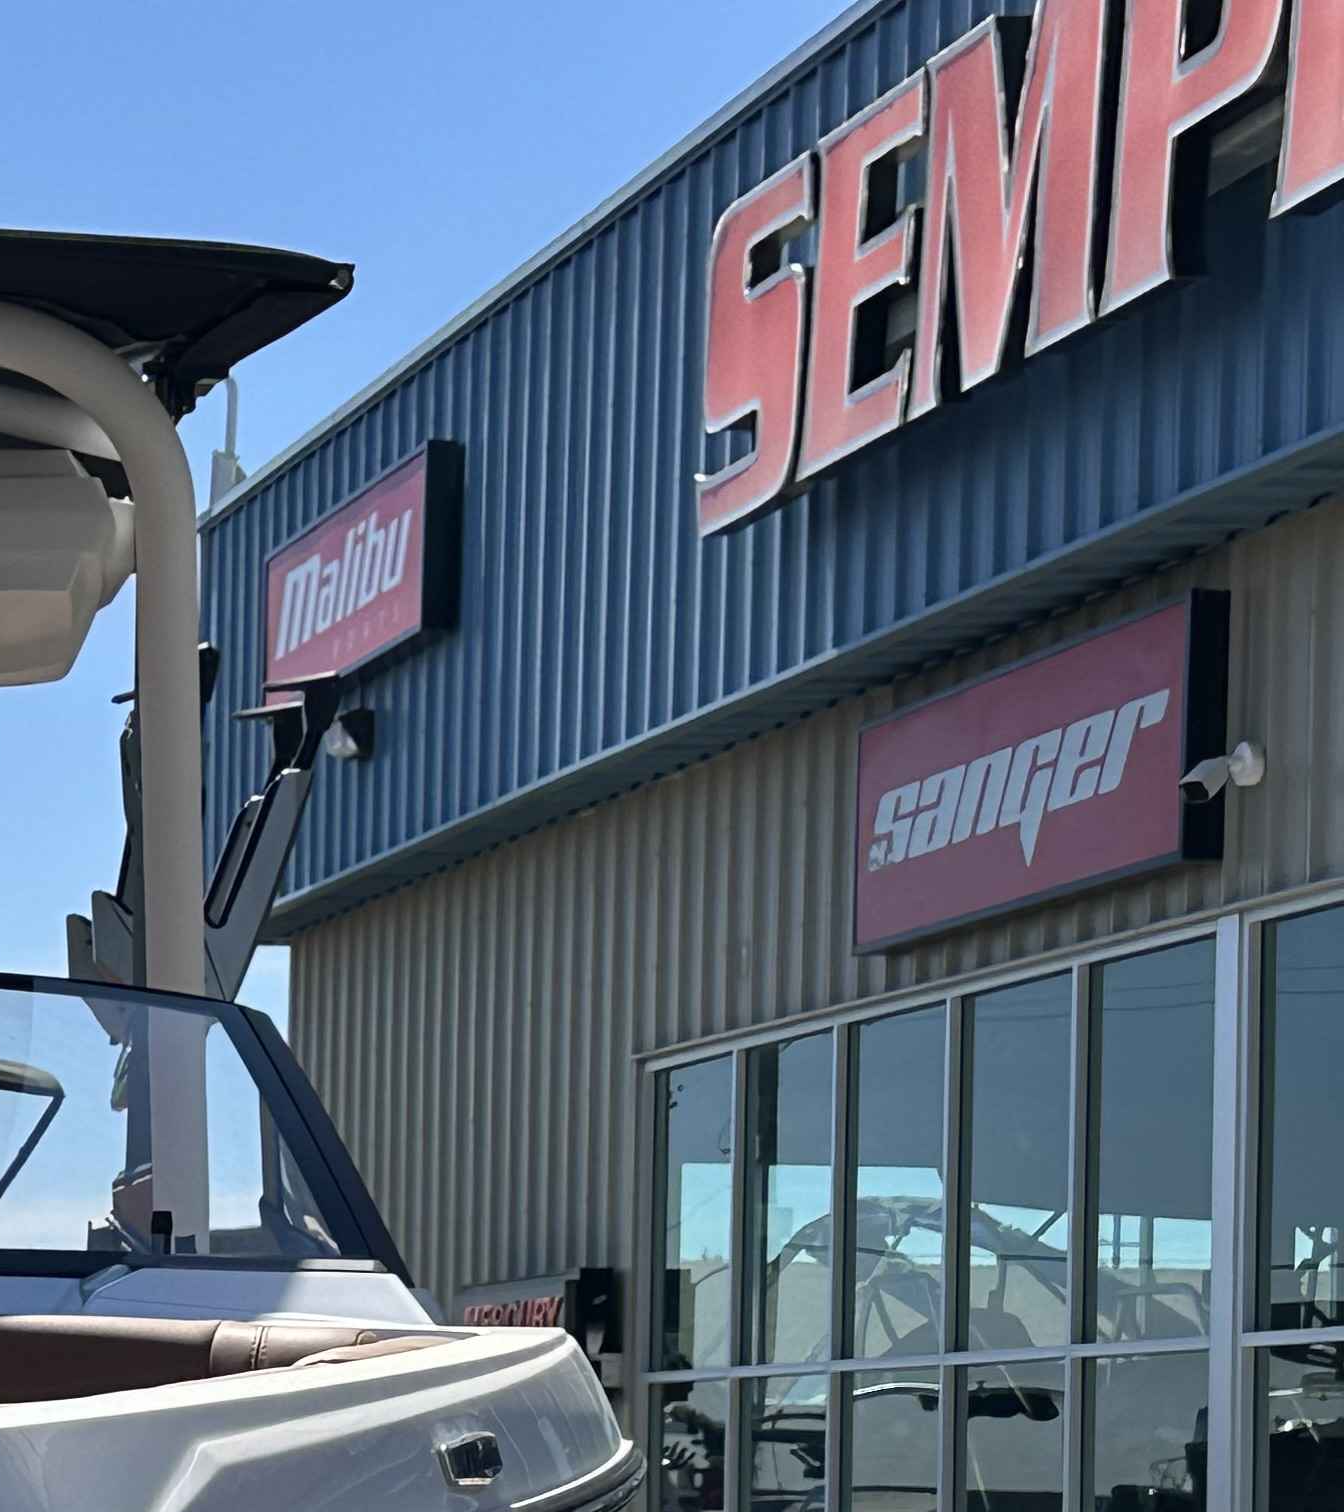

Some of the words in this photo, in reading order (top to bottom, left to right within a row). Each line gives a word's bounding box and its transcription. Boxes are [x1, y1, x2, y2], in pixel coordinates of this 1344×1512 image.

[694, 0, 1344, 539] SEMP
[274, 508, 413, 661] Malibu
[870, 687, 1170, 869] sanger
